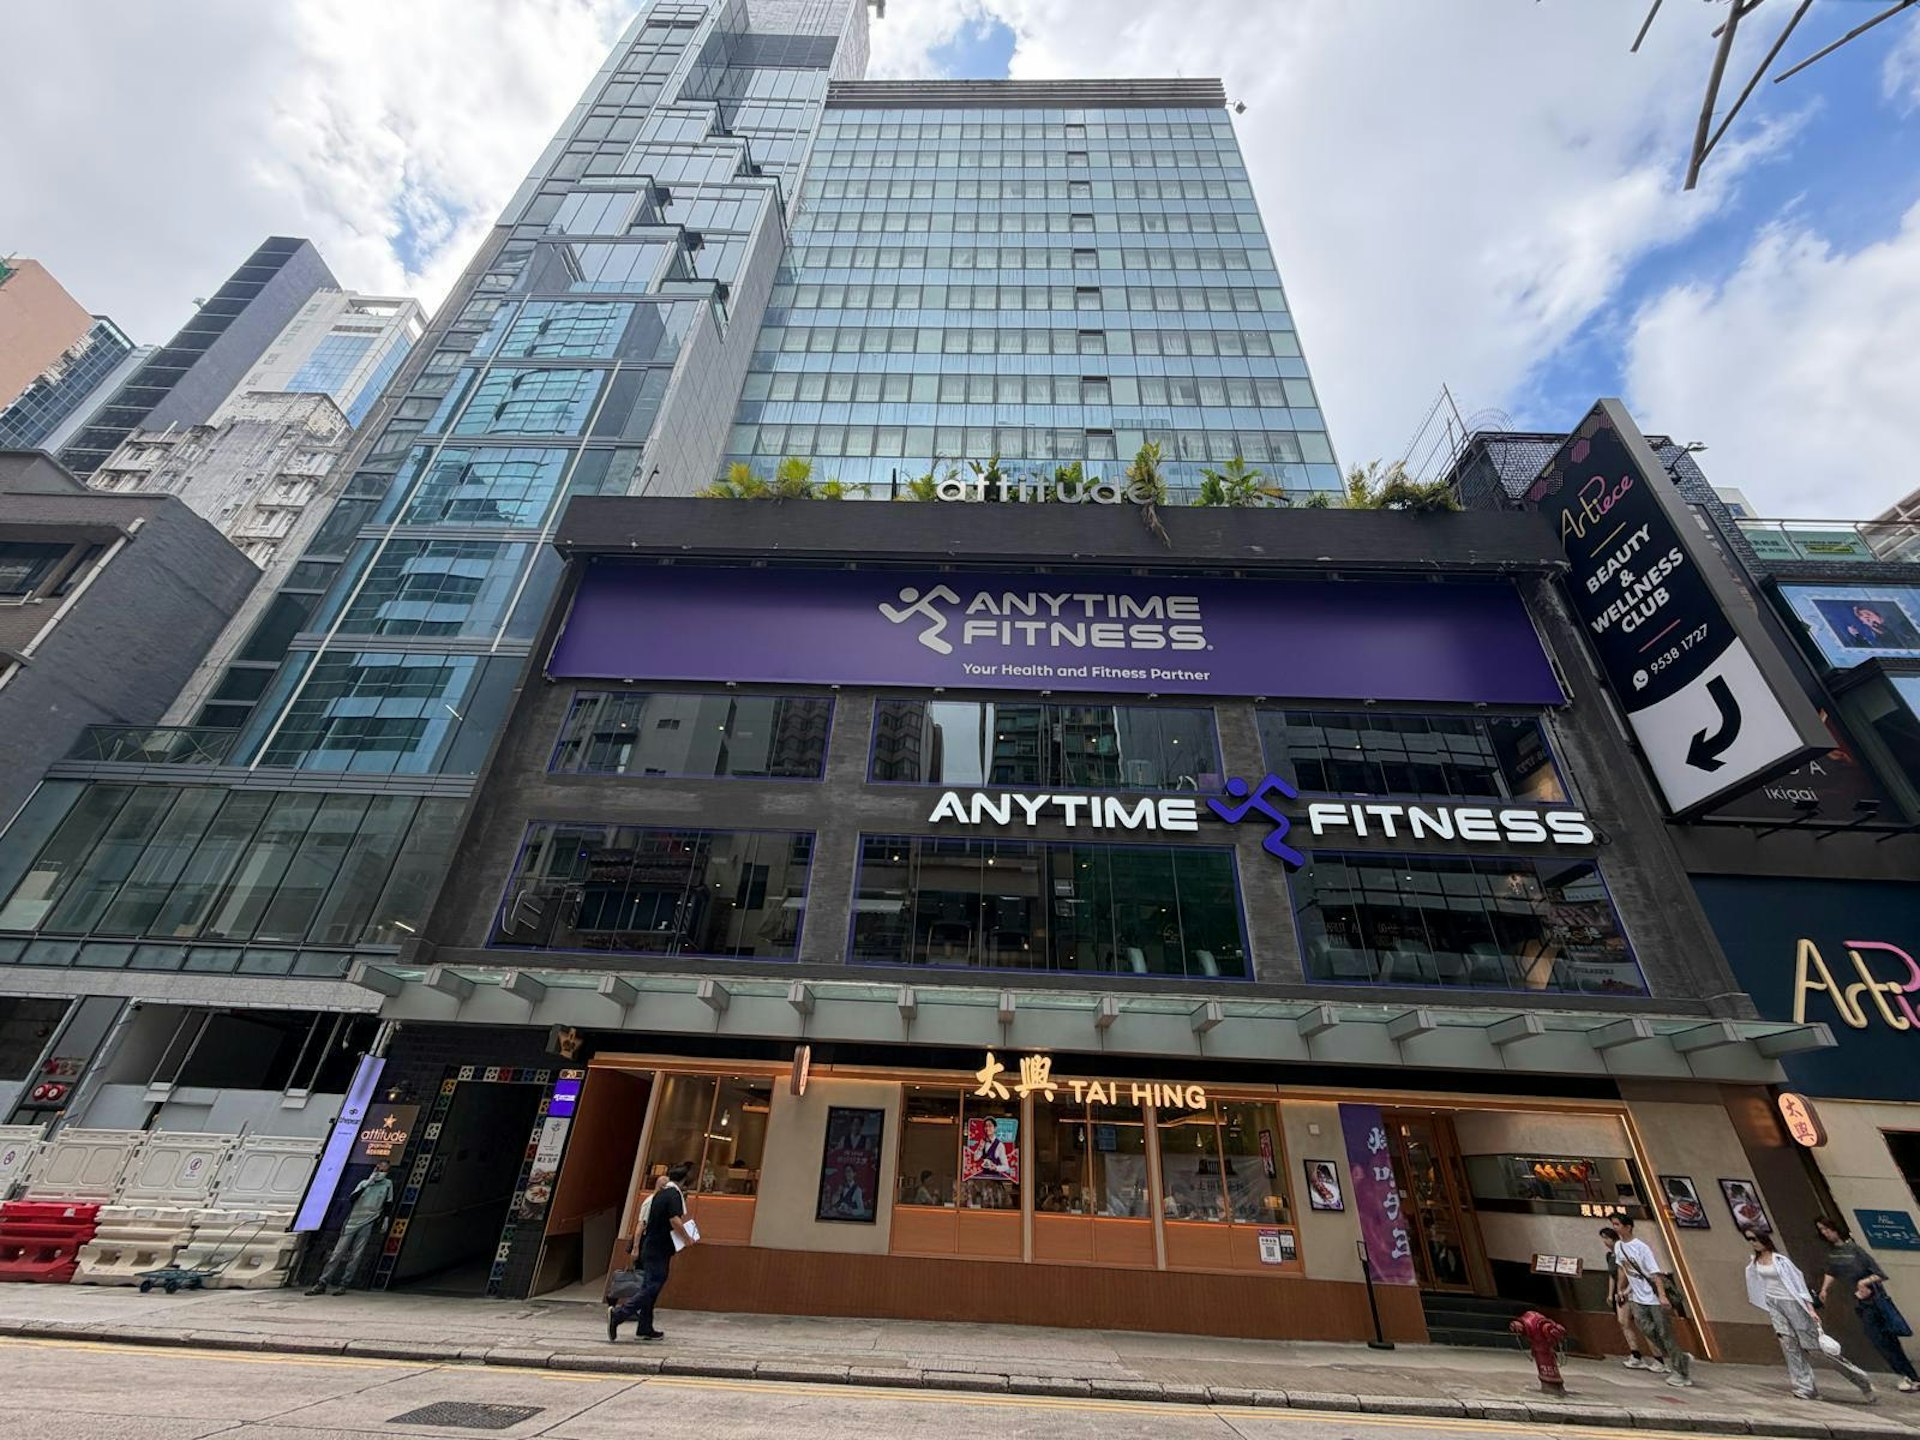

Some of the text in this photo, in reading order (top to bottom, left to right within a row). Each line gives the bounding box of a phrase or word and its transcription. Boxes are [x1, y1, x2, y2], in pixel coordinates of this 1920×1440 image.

[936, 473, 1156, 504] attitude
[1586, 523, 1650, 594] BEAUTY
[1591, 547, 1684, 634] WELLNESS
[1619, 569, 1636, 588] &
[965, 591, 1201, 620] ANYTIME
[1621, 587, 1670, 633] CLUB
[1650, 623, 1708, 675] 9538 1727
[962, 663, 1210, 681] Your Health and Fitness Partner
[928, 792, 1595, 845] ANYTIME FITNESS
[974, 1051, 1059, 1102] 太興
[1068, 1080, 1207, 1110] TAI HING
[360, 1128, 408, 1142] attitude
